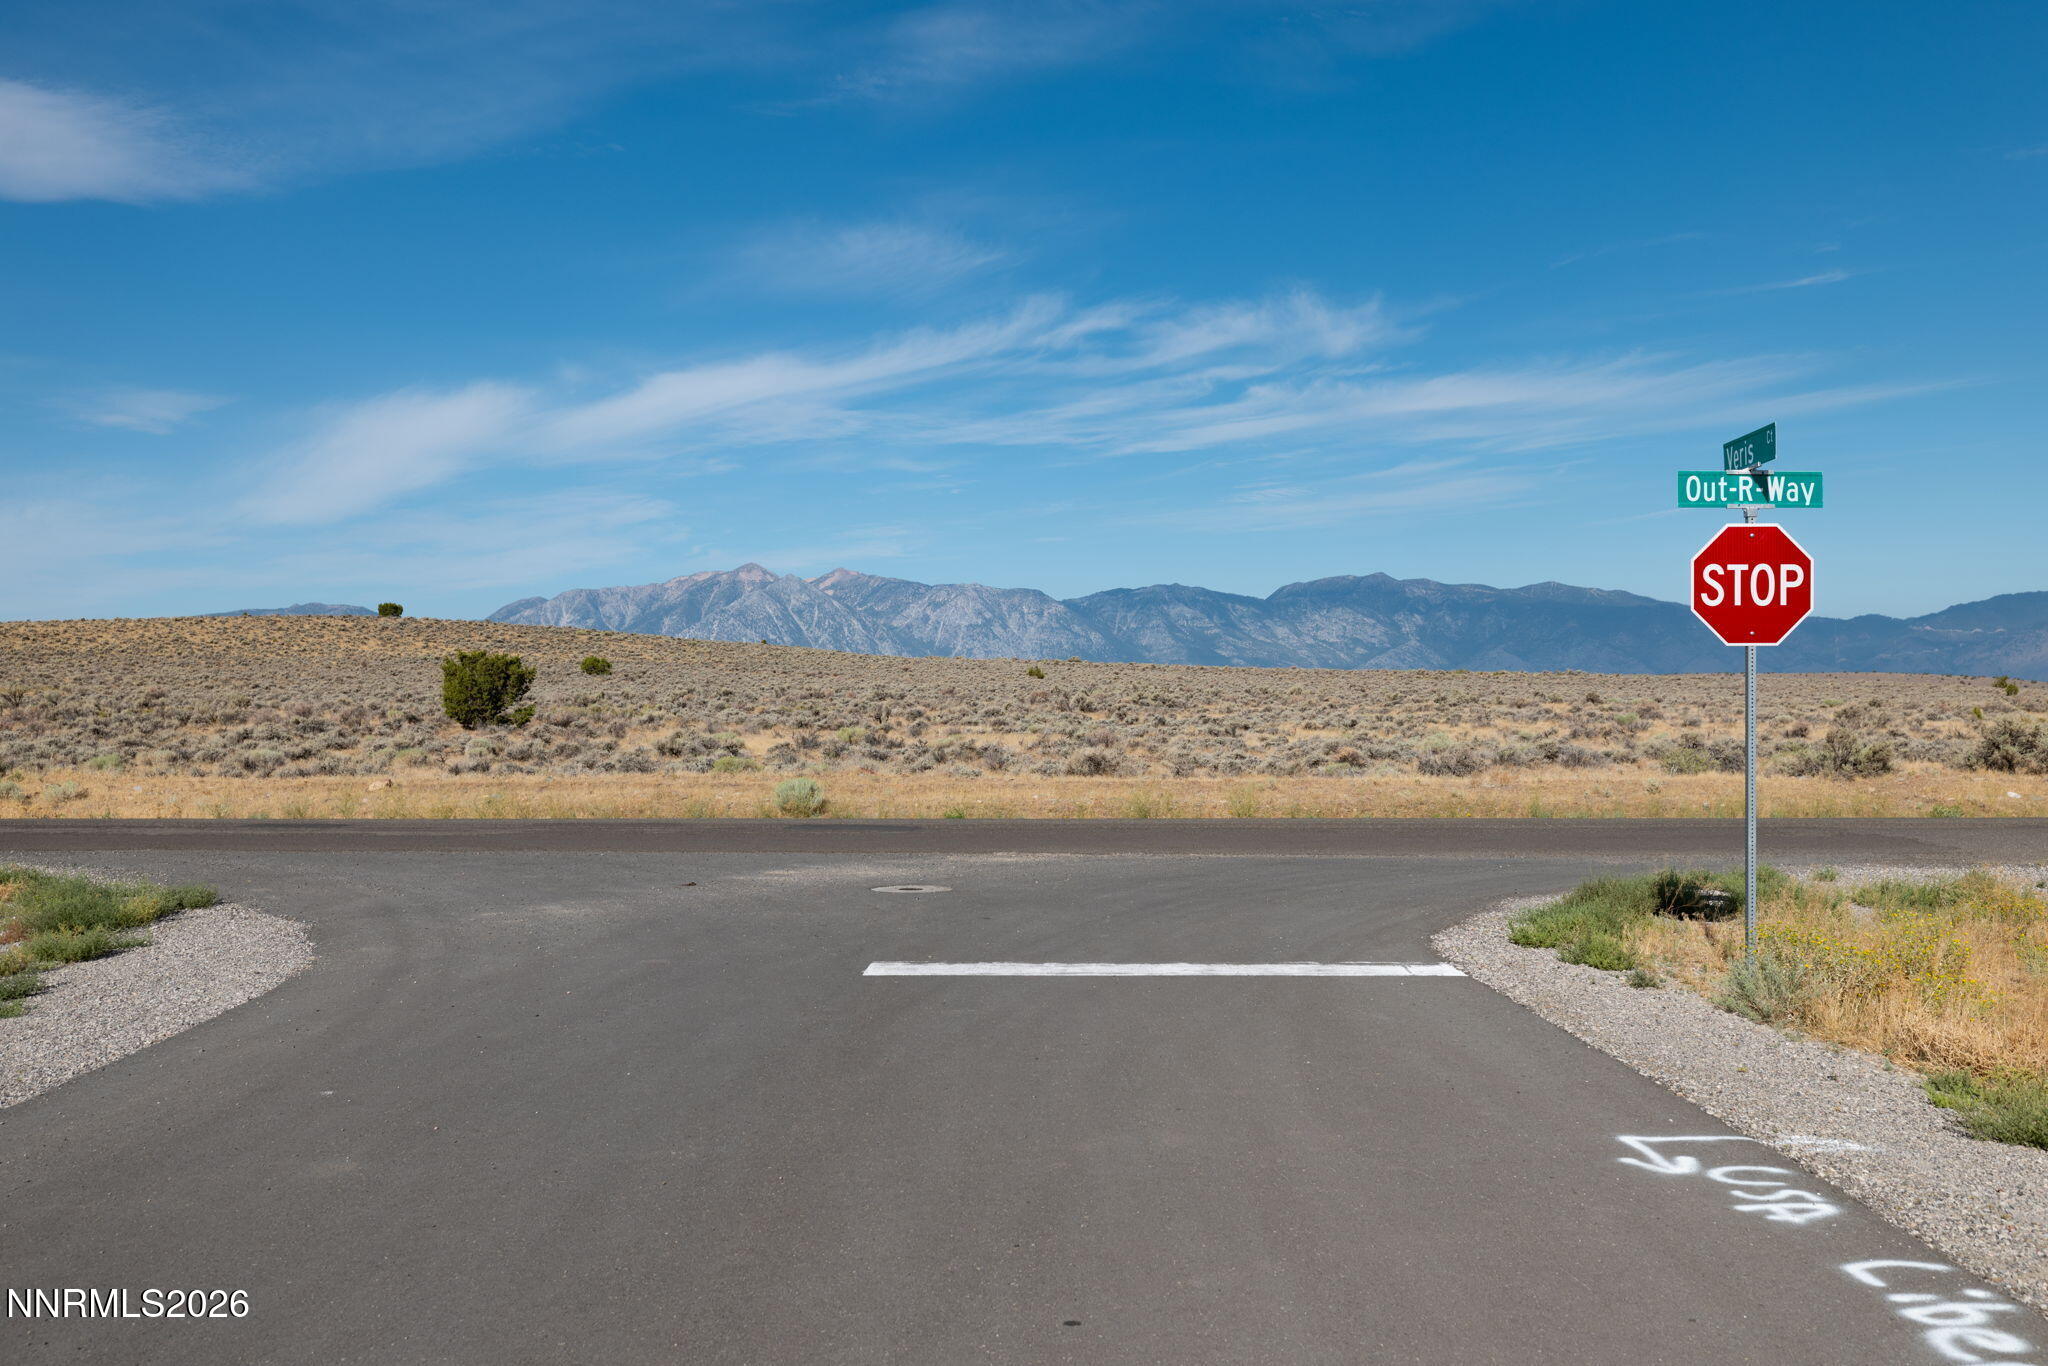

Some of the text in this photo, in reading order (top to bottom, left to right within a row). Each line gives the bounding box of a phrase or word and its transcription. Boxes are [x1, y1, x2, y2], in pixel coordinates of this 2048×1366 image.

[1726, 430, 1773, 471] Veris Ct
[1685, 475, 1815, 506] Out-R-Way
[1700, 563, 1805, 607] STOP
[1839, 1259, 2033, 1366] Libe
